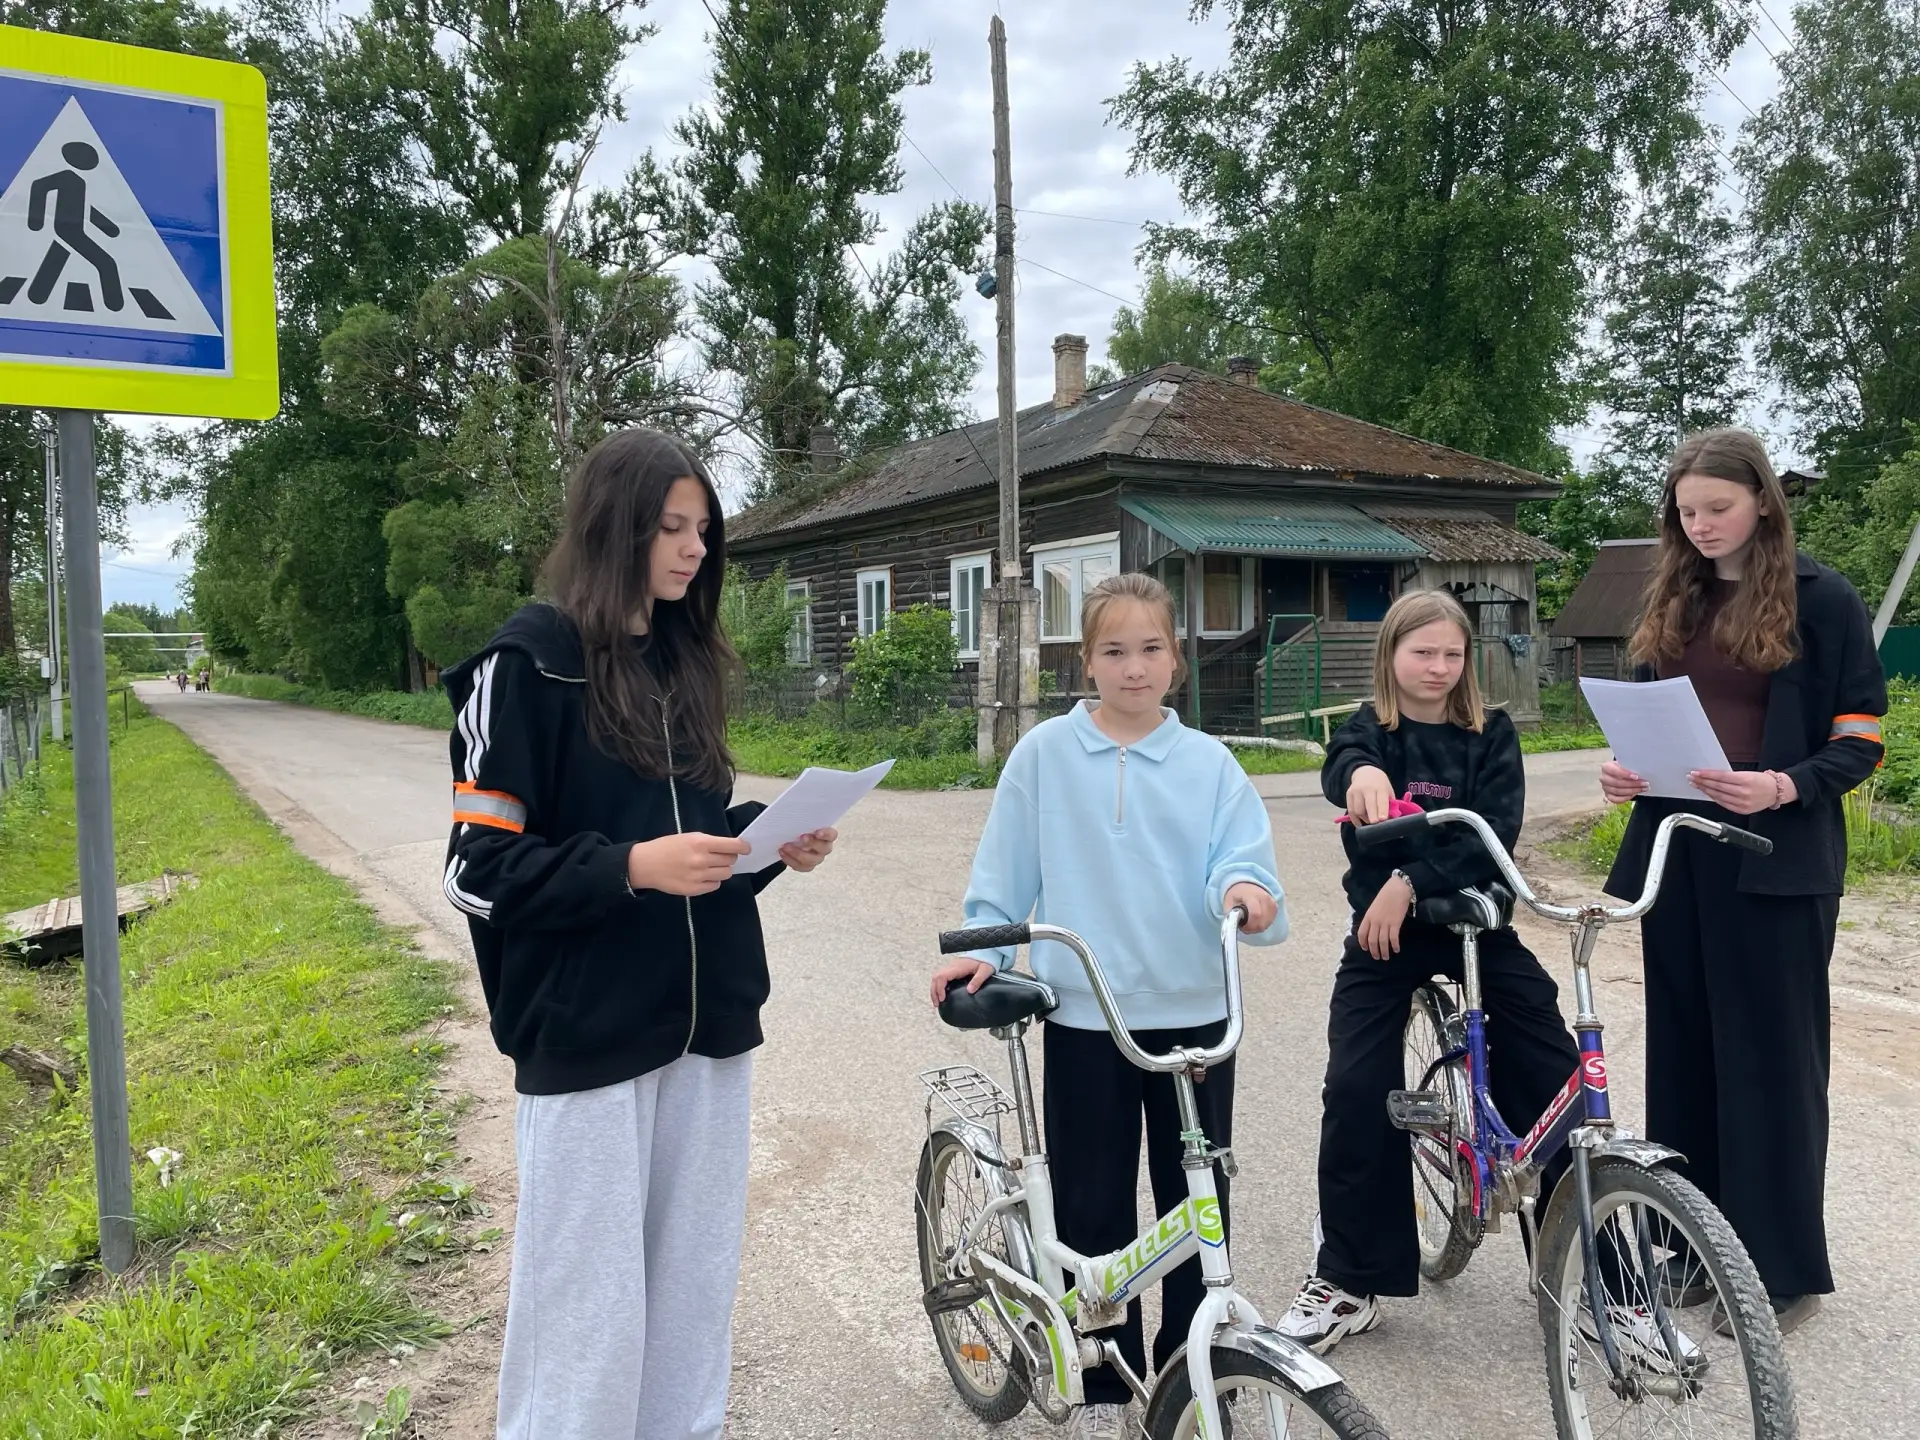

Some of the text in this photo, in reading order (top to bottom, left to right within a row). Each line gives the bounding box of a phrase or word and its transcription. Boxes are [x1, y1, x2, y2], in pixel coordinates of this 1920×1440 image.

[1585, 1057, 1607, 1077] S
[1200, 1204, 1222, 1230] S
[1111, 1203, 1188, 1287] STELS
